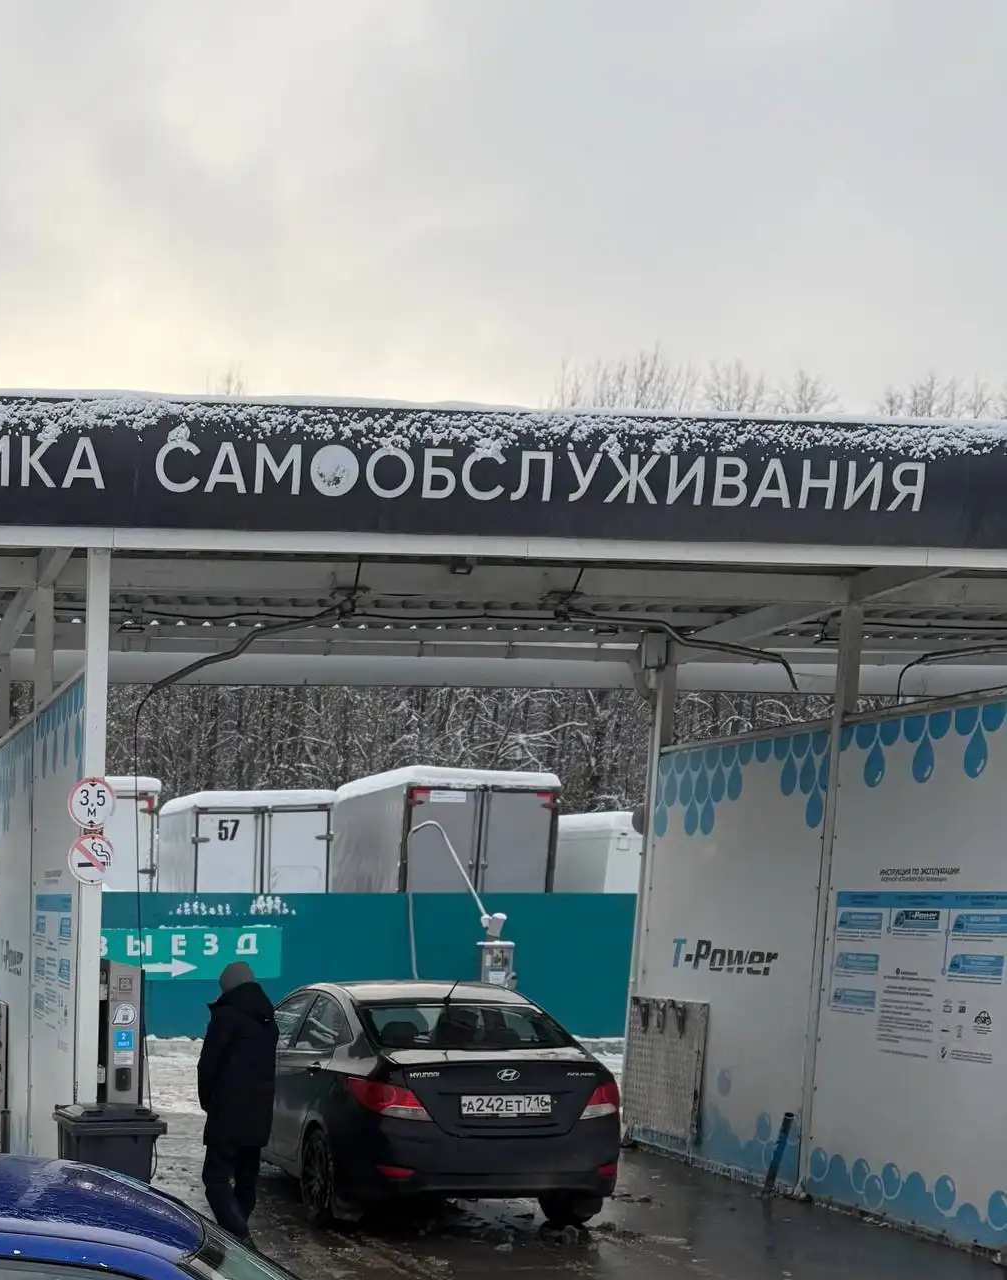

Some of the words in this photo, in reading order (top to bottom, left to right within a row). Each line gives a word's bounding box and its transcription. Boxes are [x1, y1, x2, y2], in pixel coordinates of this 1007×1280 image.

[154, 440, 928, 512] САМООБСЛУЖИВАНИЯ
[218, 819, 240, 841] 57
[672, 938, 779, 976] T-Power
